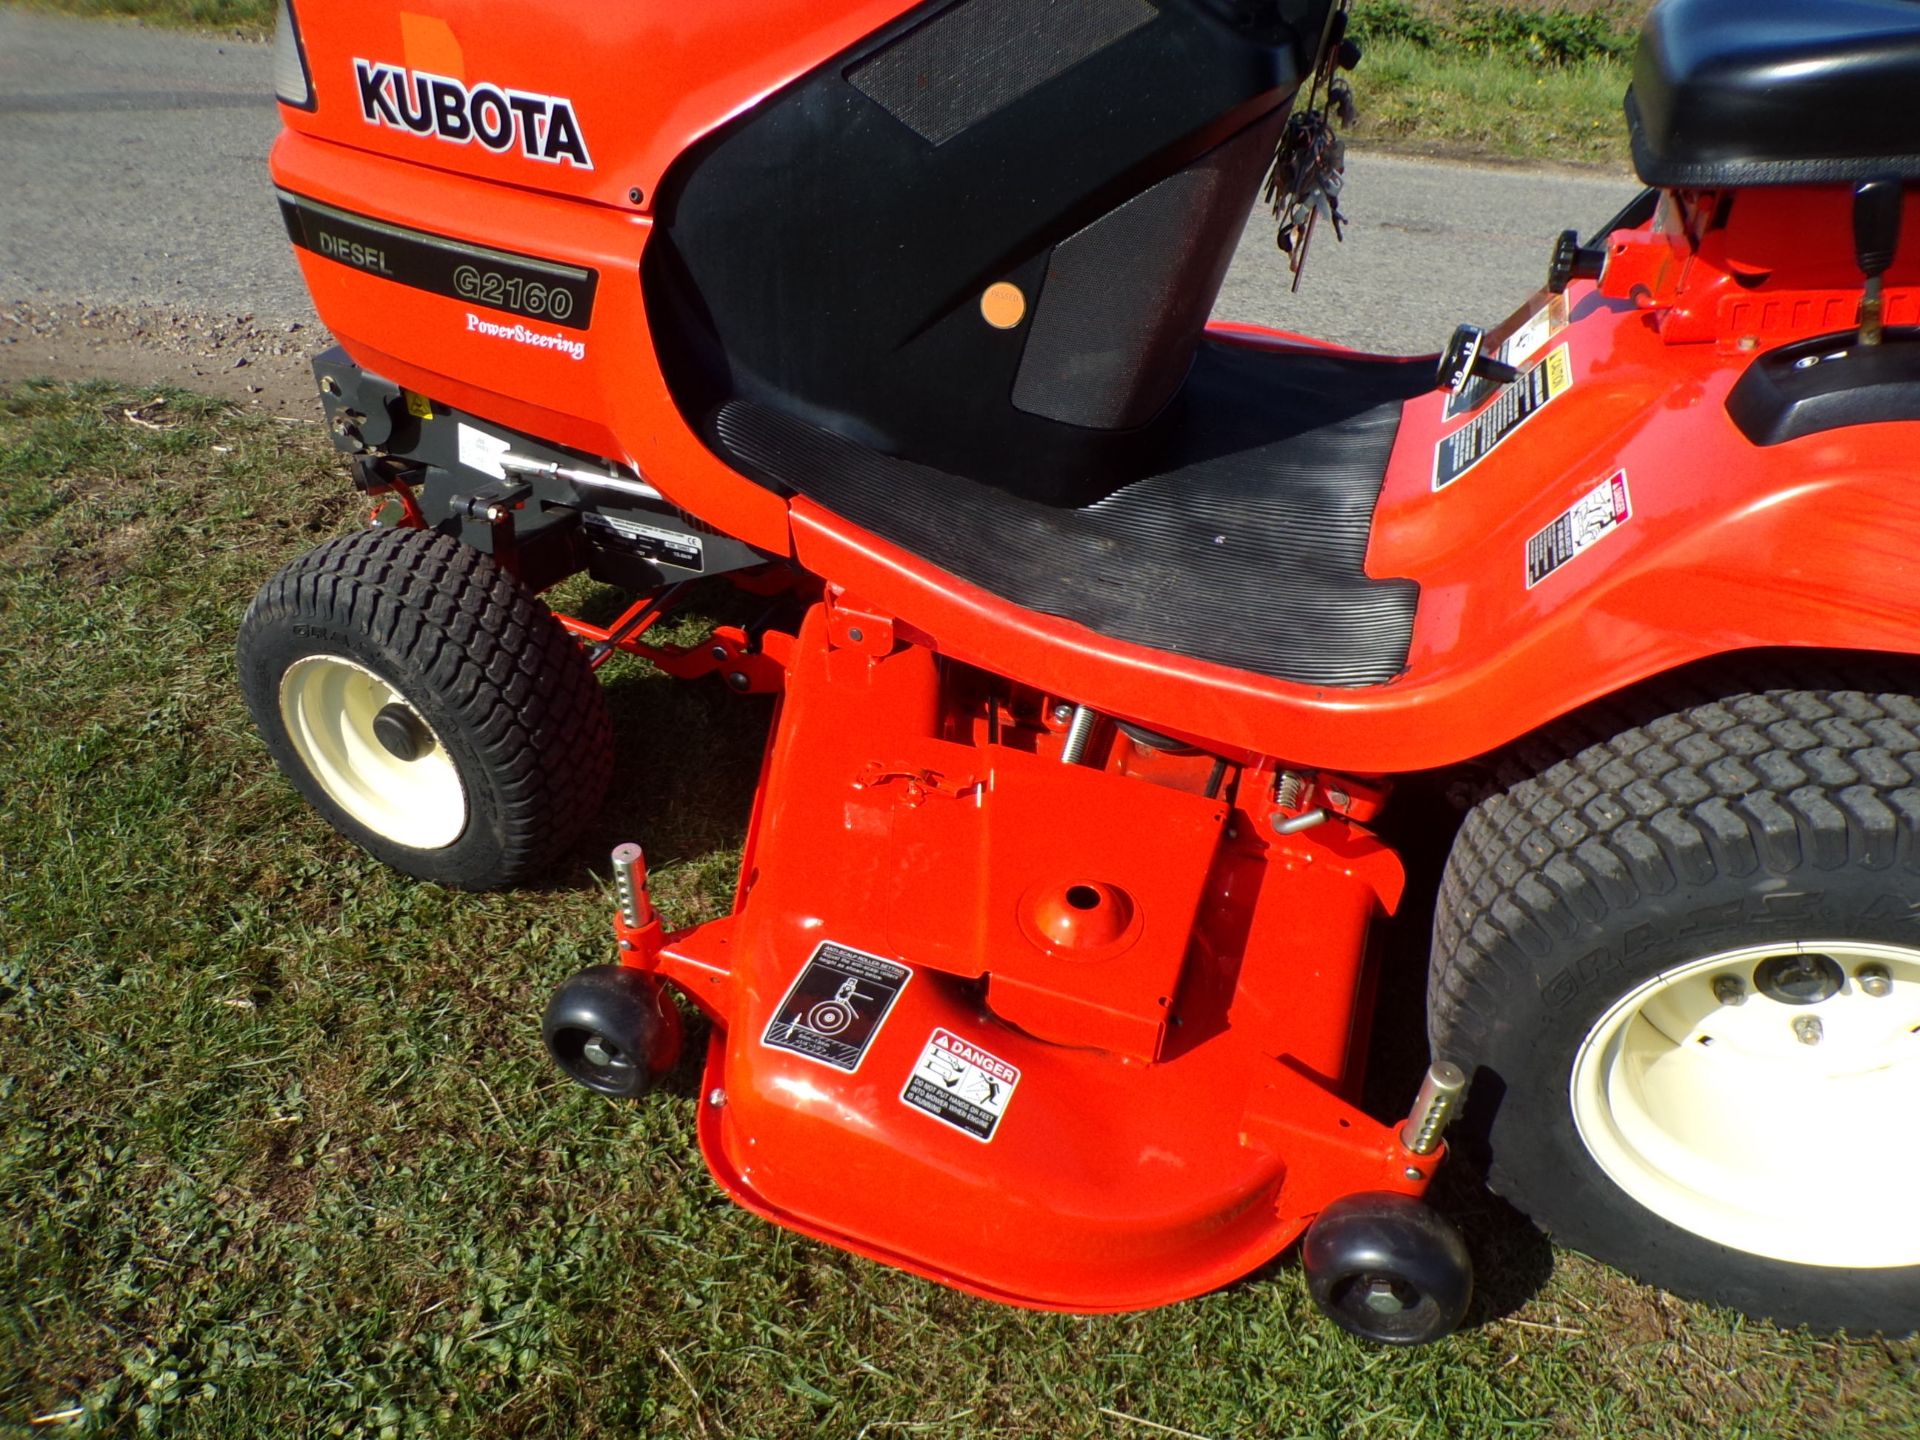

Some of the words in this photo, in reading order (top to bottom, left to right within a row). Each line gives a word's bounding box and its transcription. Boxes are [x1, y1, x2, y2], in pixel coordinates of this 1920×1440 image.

[353, 57, 594, 170] KUBOTA
[318, 231, 394, 277] DIESEL
[453, 264, 574, 319] G2160
[950, 1040, 1015, 1082] DANGER
[907, 1091, 915, 1100] IS
[914, 1095, 942, 1114] RUNNING
[910, 1084, 926, 1097] INTO
[926, 1091, 950, 1109] MOWER
[949, 1103, 968, 1118] WHEN
[966, 1111, 990, 1129] ENGINE
[914, 1077, 924, 1086] DO
[924, 1081, 937, 1093] NOT
[936, 1086, 950, 1100] PUT
[949, 1092, 971, 1110] HANDS
[970, 1104, 980, 1114] OR
[979, 1108, 995, 1122] FEET
